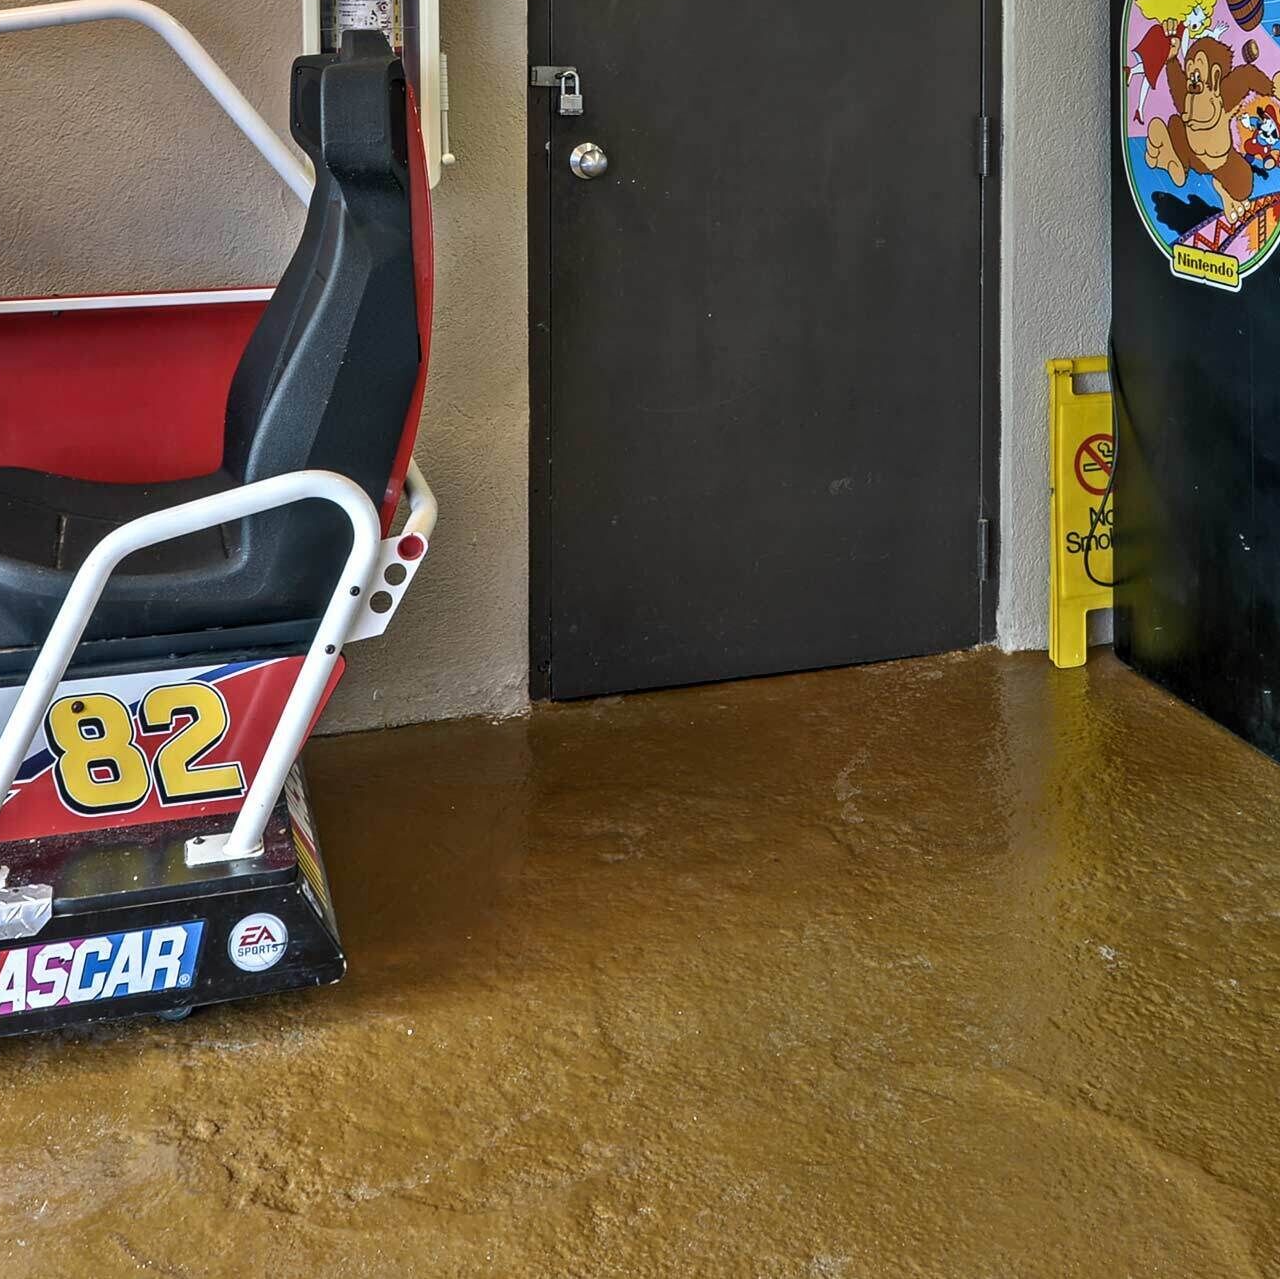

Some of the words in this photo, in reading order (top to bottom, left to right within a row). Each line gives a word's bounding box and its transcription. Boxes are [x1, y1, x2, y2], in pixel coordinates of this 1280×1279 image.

[1177, 251, 1234, 278] Nintendo
[46, 680, 247, 816] 82
[239, 926, 277, 947] EA
[237, 944, 278, 957] SPORTS
